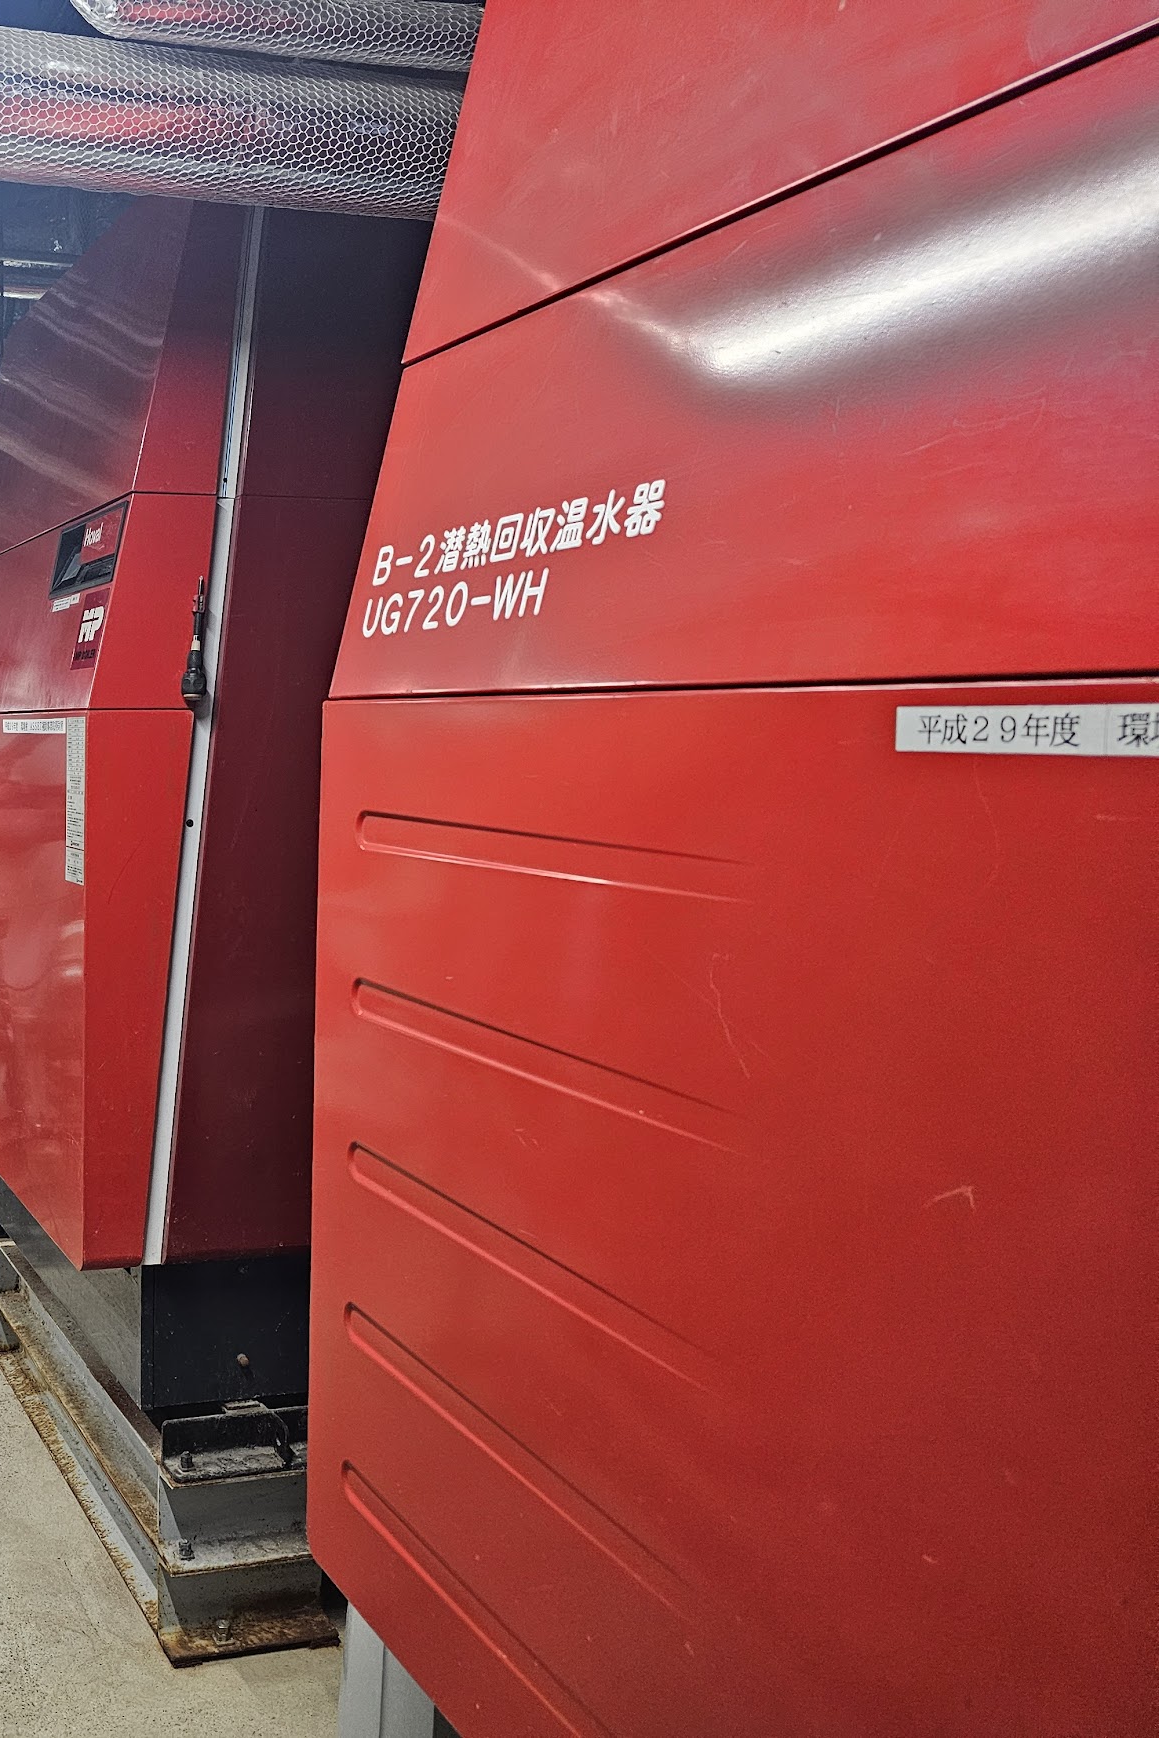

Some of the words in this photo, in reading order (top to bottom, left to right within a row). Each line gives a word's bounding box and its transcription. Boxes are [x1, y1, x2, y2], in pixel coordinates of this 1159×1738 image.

[83, 521, 104, 547] Hoval
[372, 479, 666, 586] B-2潜熱回収温水器
[362, 567, 549, 638] UG720-WH
[917, 712, 1081, 748] 平成29年度
